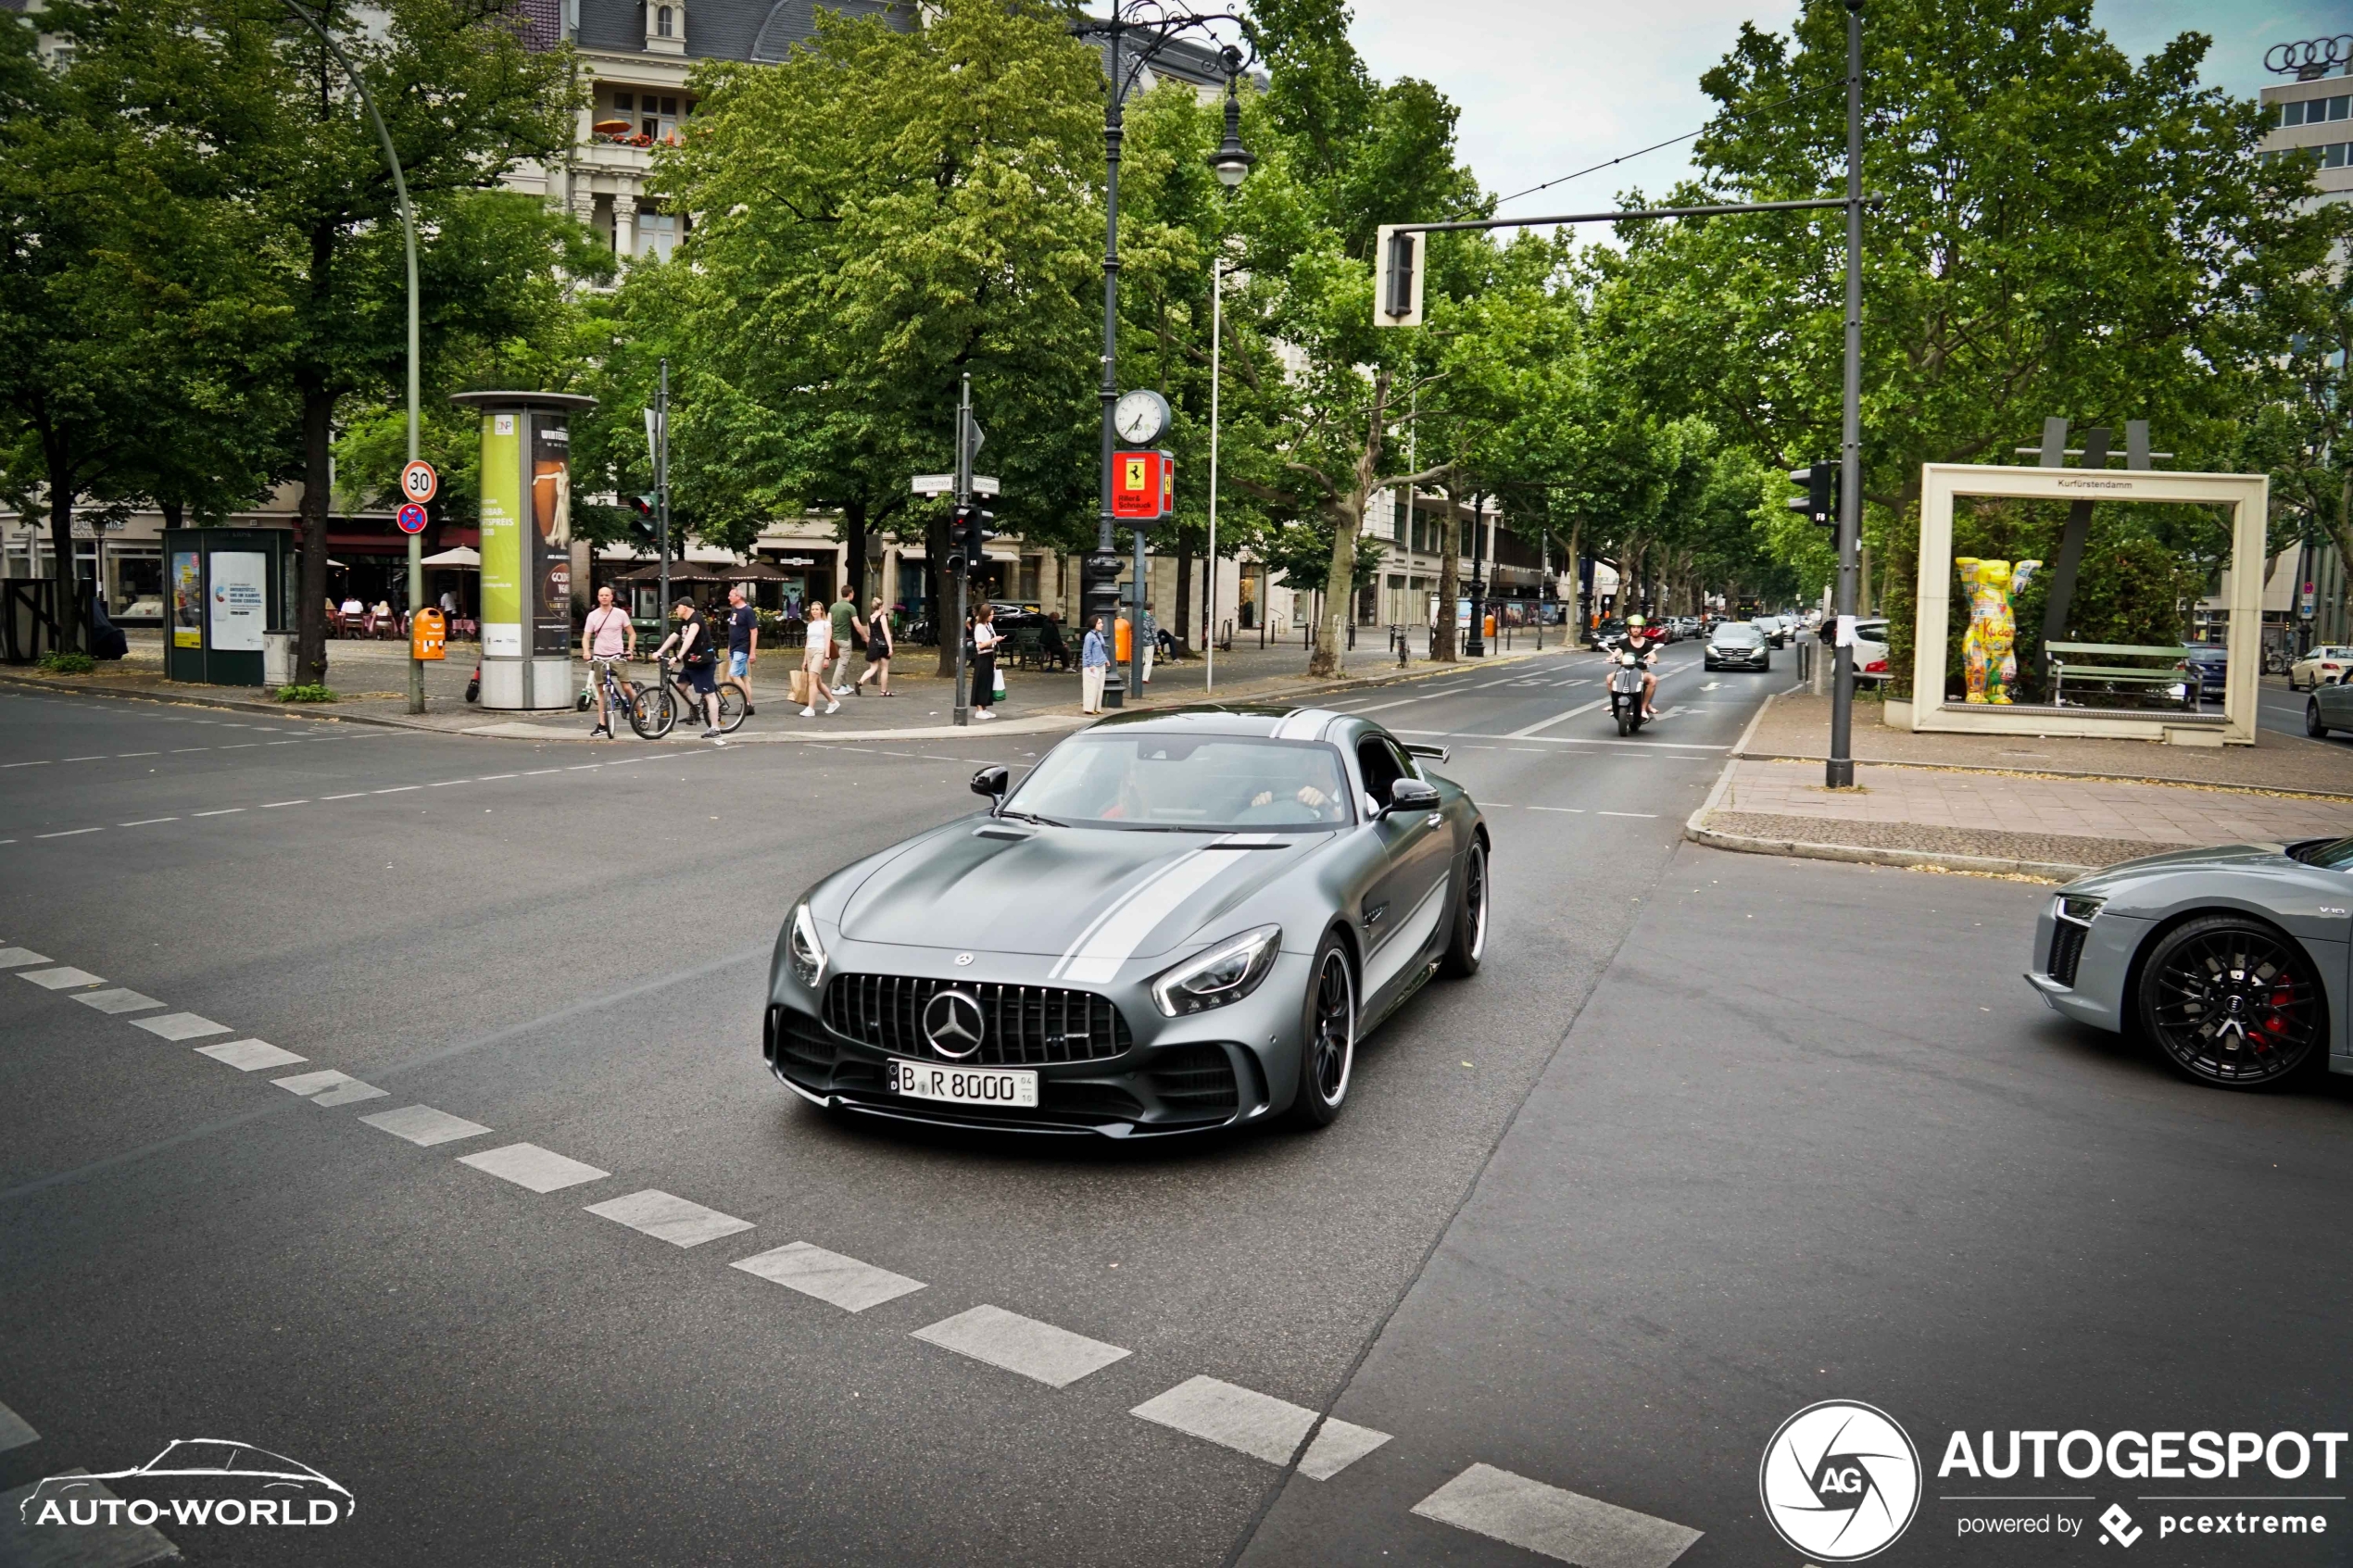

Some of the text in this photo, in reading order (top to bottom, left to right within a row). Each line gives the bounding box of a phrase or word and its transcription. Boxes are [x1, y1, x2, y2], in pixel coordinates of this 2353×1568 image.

[409, 472, 429, 491] 30
[2057, 480, 2133, 489] Kurfürstendamm
[1816, 513, 1826, 521] F8
[902, 1067, 1014, 1100] B R 8000
